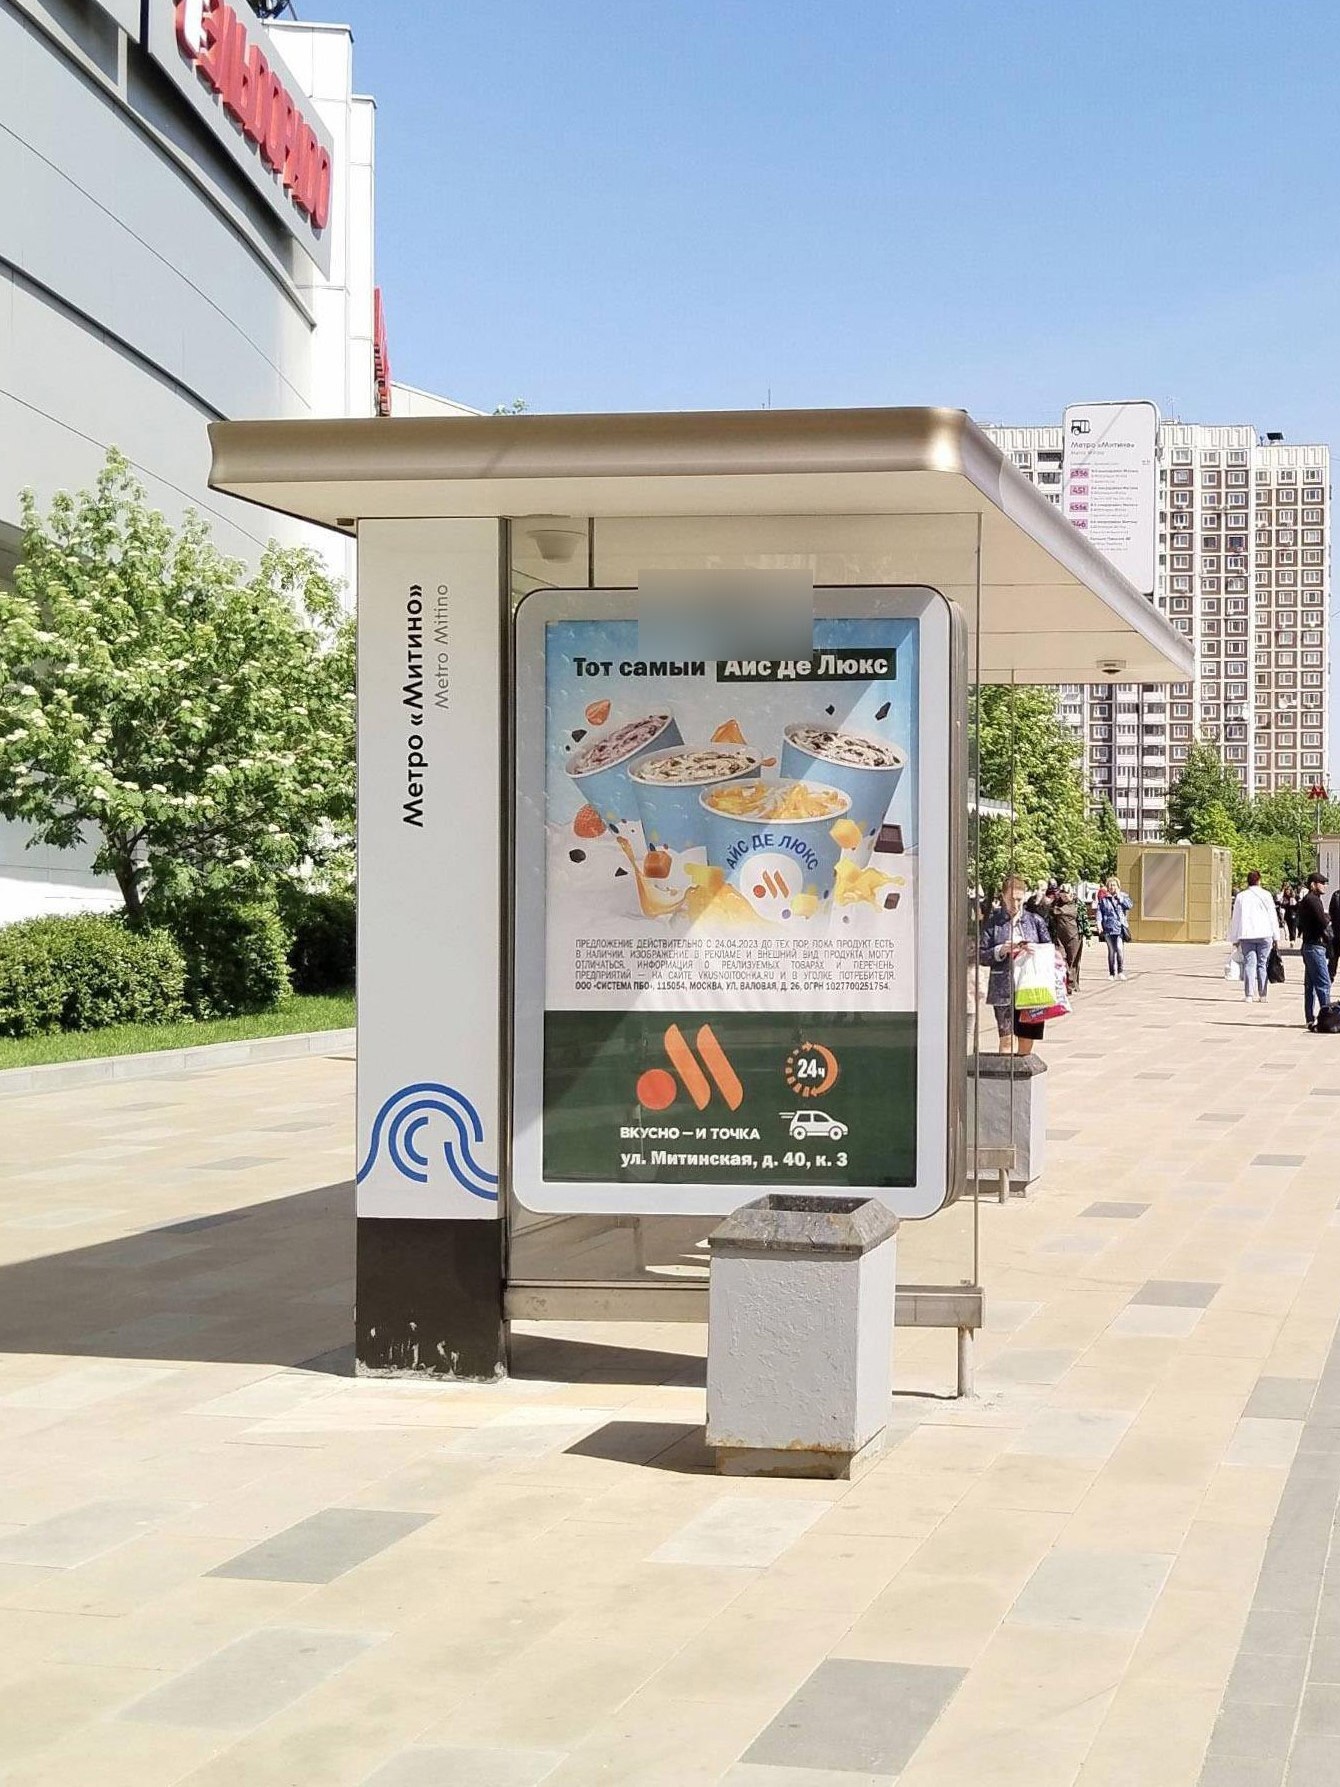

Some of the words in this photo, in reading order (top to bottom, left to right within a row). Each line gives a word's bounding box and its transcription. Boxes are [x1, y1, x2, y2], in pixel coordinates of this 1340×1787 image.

[433, 583, 449, 645] Mitino
[402, 583, 424, 726] «Митино»
[573, 657, 613, 677] Тот
[777, 660, 812, 679] де
[817, 654, 889, 675] Люкс
[434, 652, 449, 710] Metro
[402, 734, 428, 828] Метро
[726, 840, 749, 870] АЙС
[752, 833, 774, 851] ДЕ
[778, 835, 819, 870] ЛЮКС
[575, 939, 634, 949] ПРЕДЛОЖЕНИЕ
[636, 939, 702, 949] ДЕЙСТВИТЕЛЬНО
[715, 939, 758, 949] 24.04.2023
[761, 939, 772, 949] ДО
[775, 939, 789, 949] ТЕХ
[793, 939, 808, 949] ПОР
[812, 939, 834, 949] ПОКА
[837, 939, 872, 949] ПРОДУКТ
[875, 939, 894, 949] ЕСТЬ
[576, 950, 581, 959] В
[630, 950, 688, 959] ИЗОБРАЖЕНИЕ
[705, 950, 741, 959] РЕКЛАМЕ
[746, 950, 752, 959] И
[758, 950, 797, 959] ВНЕШНИЙ
[803, 950, 818, 959] ВИД
[824, 950, 863, 959] ПРОДУКТА
[868, 950, 894, 959] МОГУТ
[638, 960, 693, 969] ИНФОРМАЦИЯ
[705, 960, 710, 969] О
[722, 960, 780, 969] РЕАЛИЗУЕМЫХ
[792, 960, 824, 969] ТОВАРАХ
[837, 960, 842, 969] И
[854, 960, 894, 969] ПЕРЕЧЕНЬ
[575, 971, 632, 980] ПРЕДПРИЯТИЙ
[652, 971, 662, 980] НА
[699, 971, 774, 980] VKUSNOITOCHKA.RU
[780, 971, 786, 980] И
[792, 971, 797, 980] В
[804, 971, 833, 980] УГОЛКЕ
[575, 981, 592, 991] ООО
[726, 981, 738, 991] УЛ.
[804, 981, 824, 991] ОГРН
[797, 1058, 826, 1078] 24ч
[619, 1127, 680, 1140] ВКУСНО
[695, 1127, 707, 1140] И
[710, 1127, 761, 1141] ТОЧКА
[621, 1153, 647, 1168] ул.
[651, 1151, 758, 1169] Митинская,
[761, 1153, 779, 1169] д.
[782, 1152, 812, 1169] 40,
[815, 1154, 832, 1167] к.
[836, 1152, 848, 1167] 3
